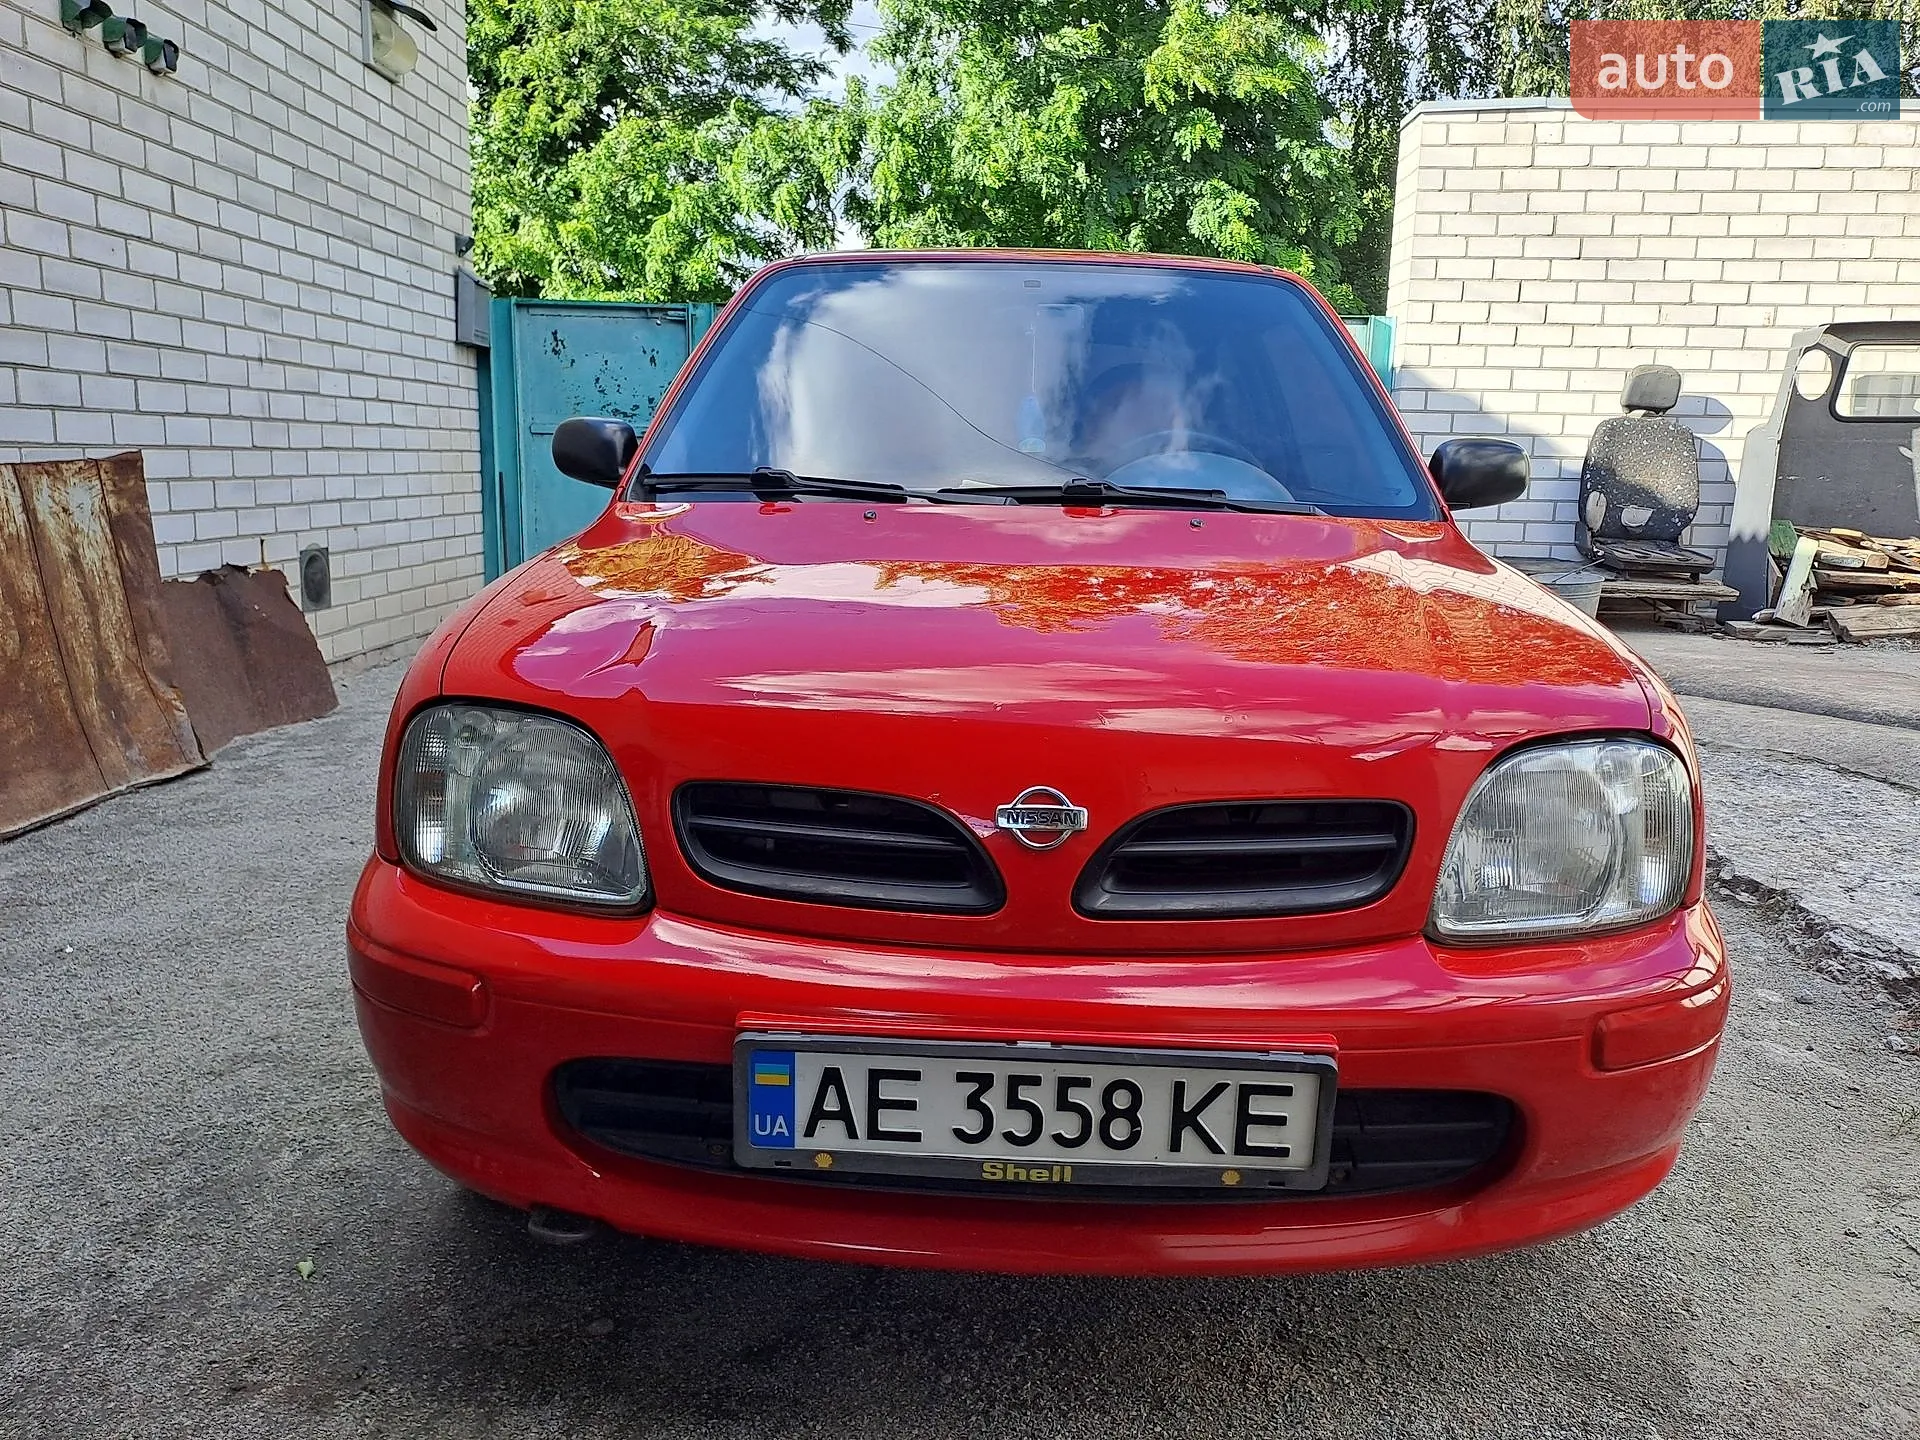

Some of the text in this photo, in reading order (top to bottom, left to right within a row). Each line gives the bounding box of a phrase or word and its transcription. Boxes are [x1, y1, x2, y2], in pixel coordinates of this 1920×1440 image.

[1006, 810, 1079, 825] NISSAN
[803, 1067, 1295, 1157] AE 3558 KE
[754, 1114, 789, 1137] UA
[982, 1163, 1072, 1184] Shell
